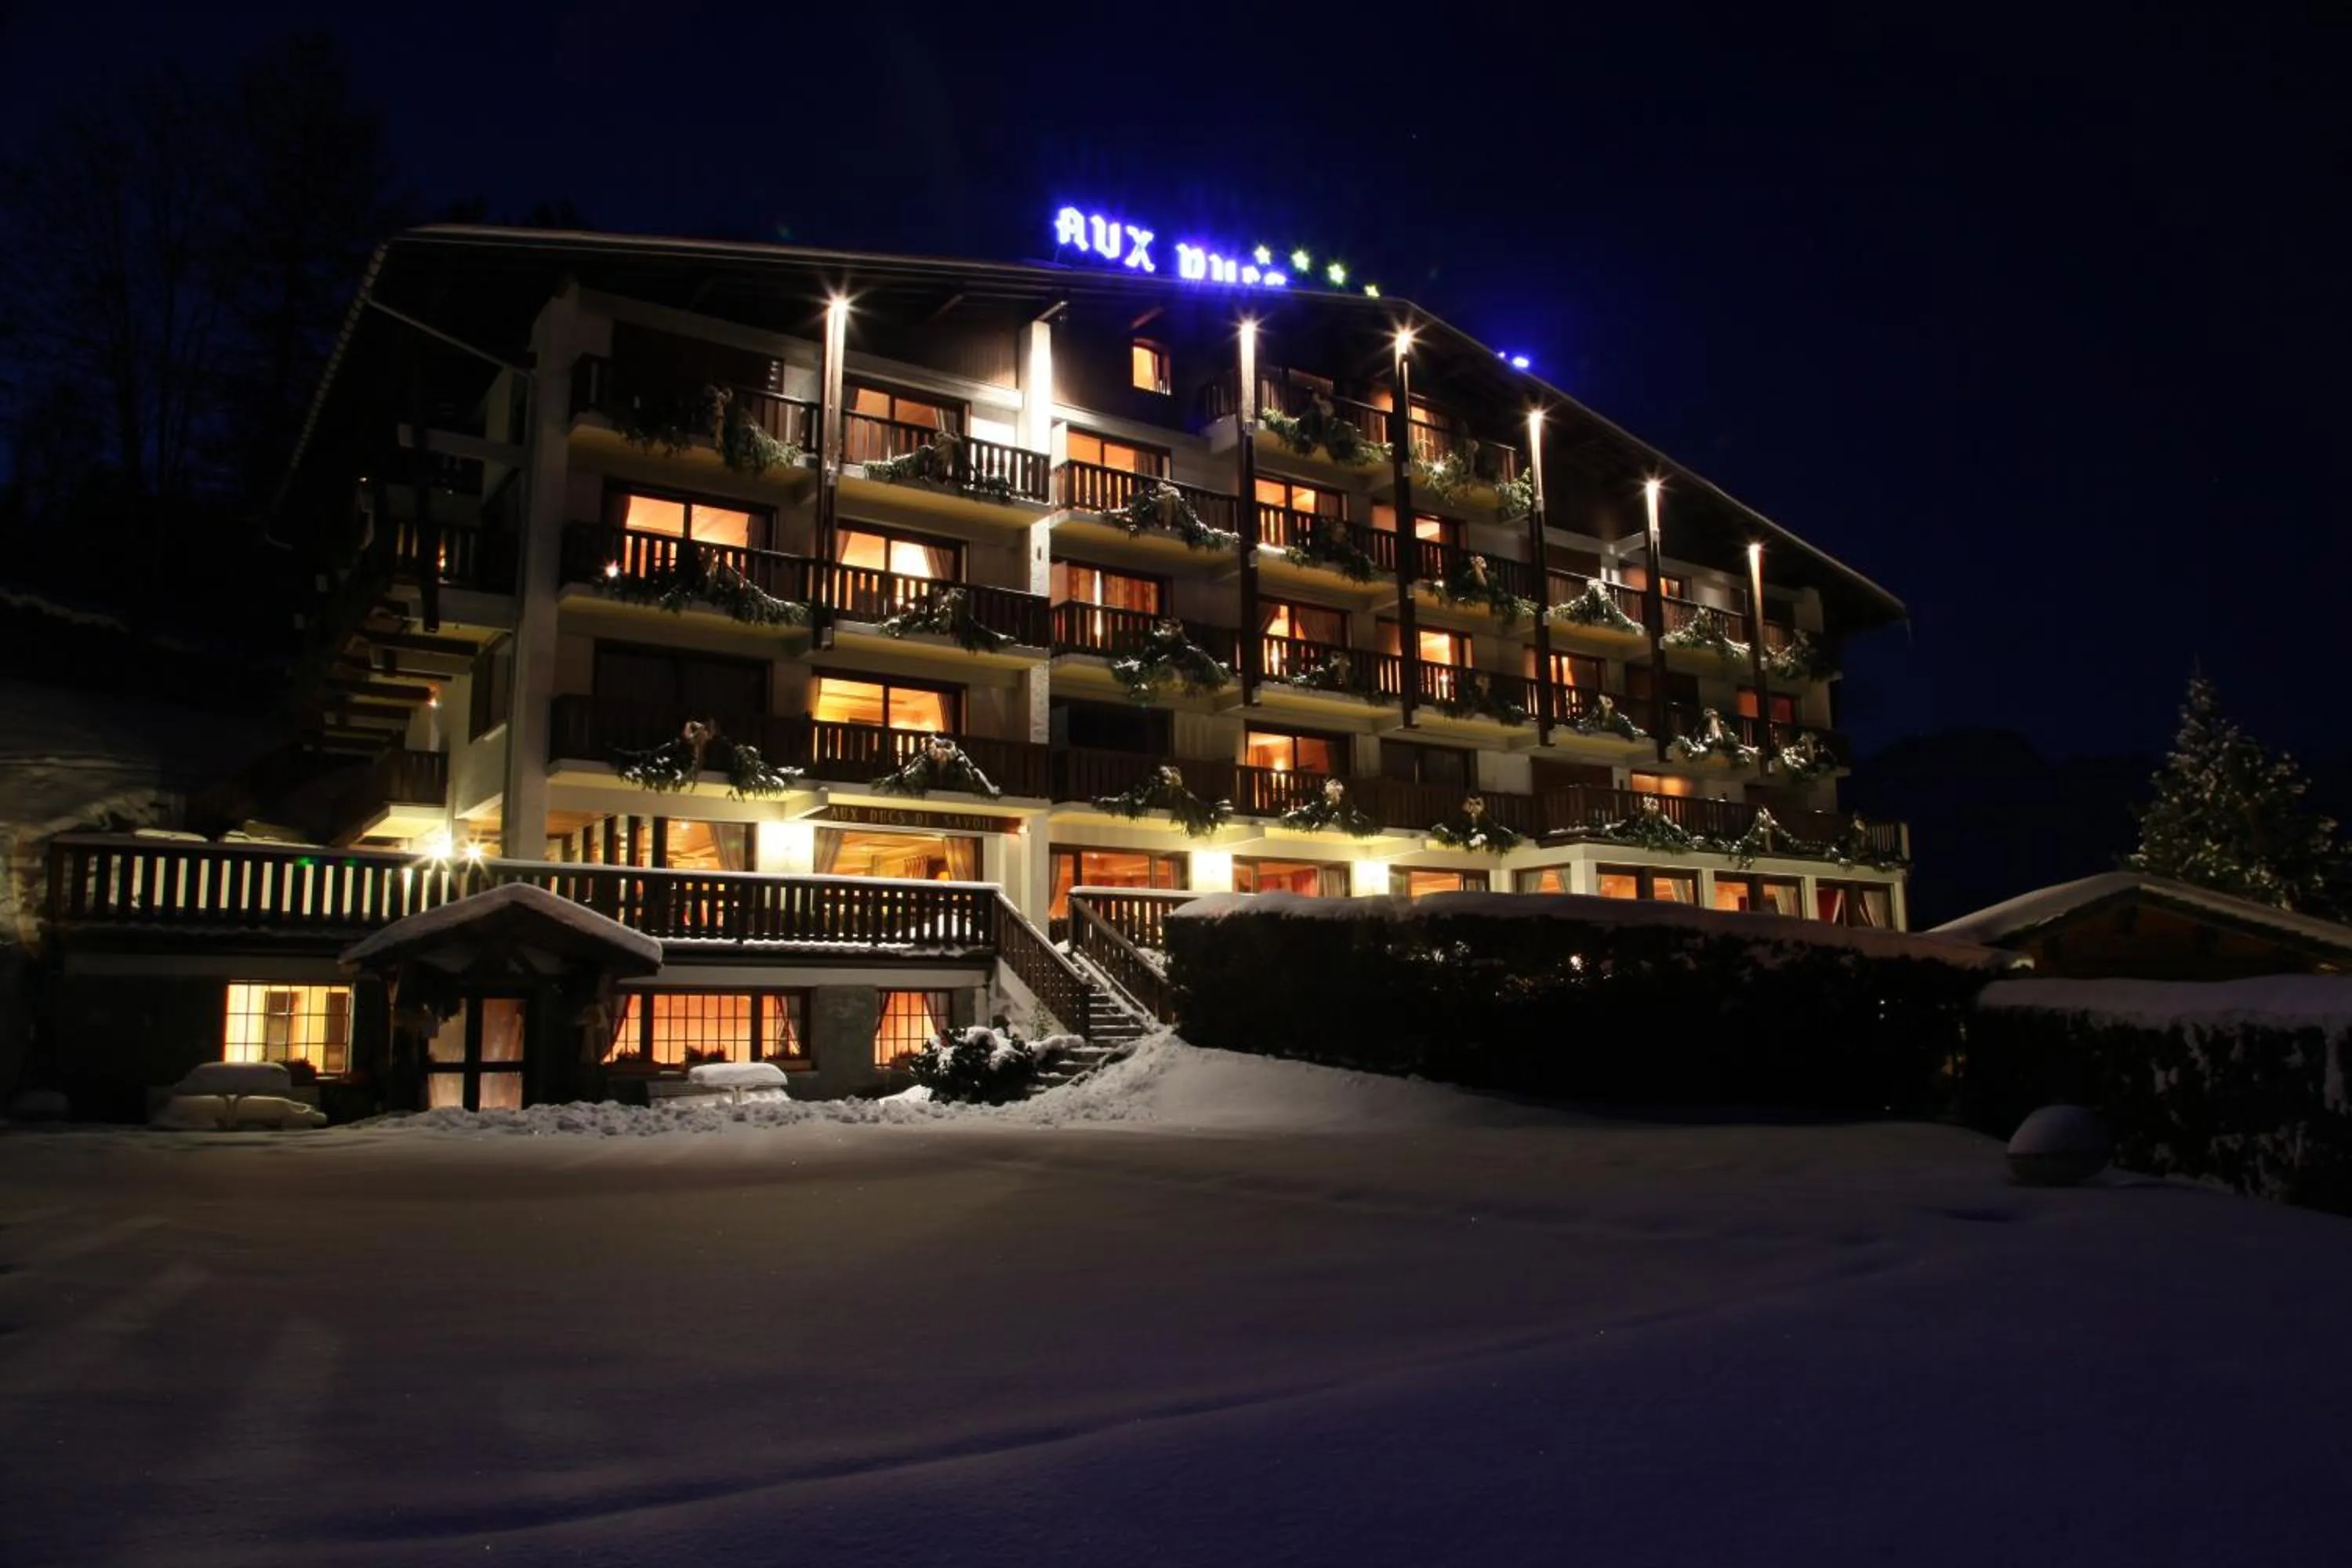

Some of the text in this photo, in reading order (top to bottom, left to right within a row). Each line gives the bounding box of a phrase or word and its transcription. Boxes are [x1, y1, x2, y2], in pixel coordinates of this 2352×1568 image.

[1054, 206, 1155, 272] AUX
[830, 805, 858, 821] AUX
[869, 808, 906, 825] DUCS
